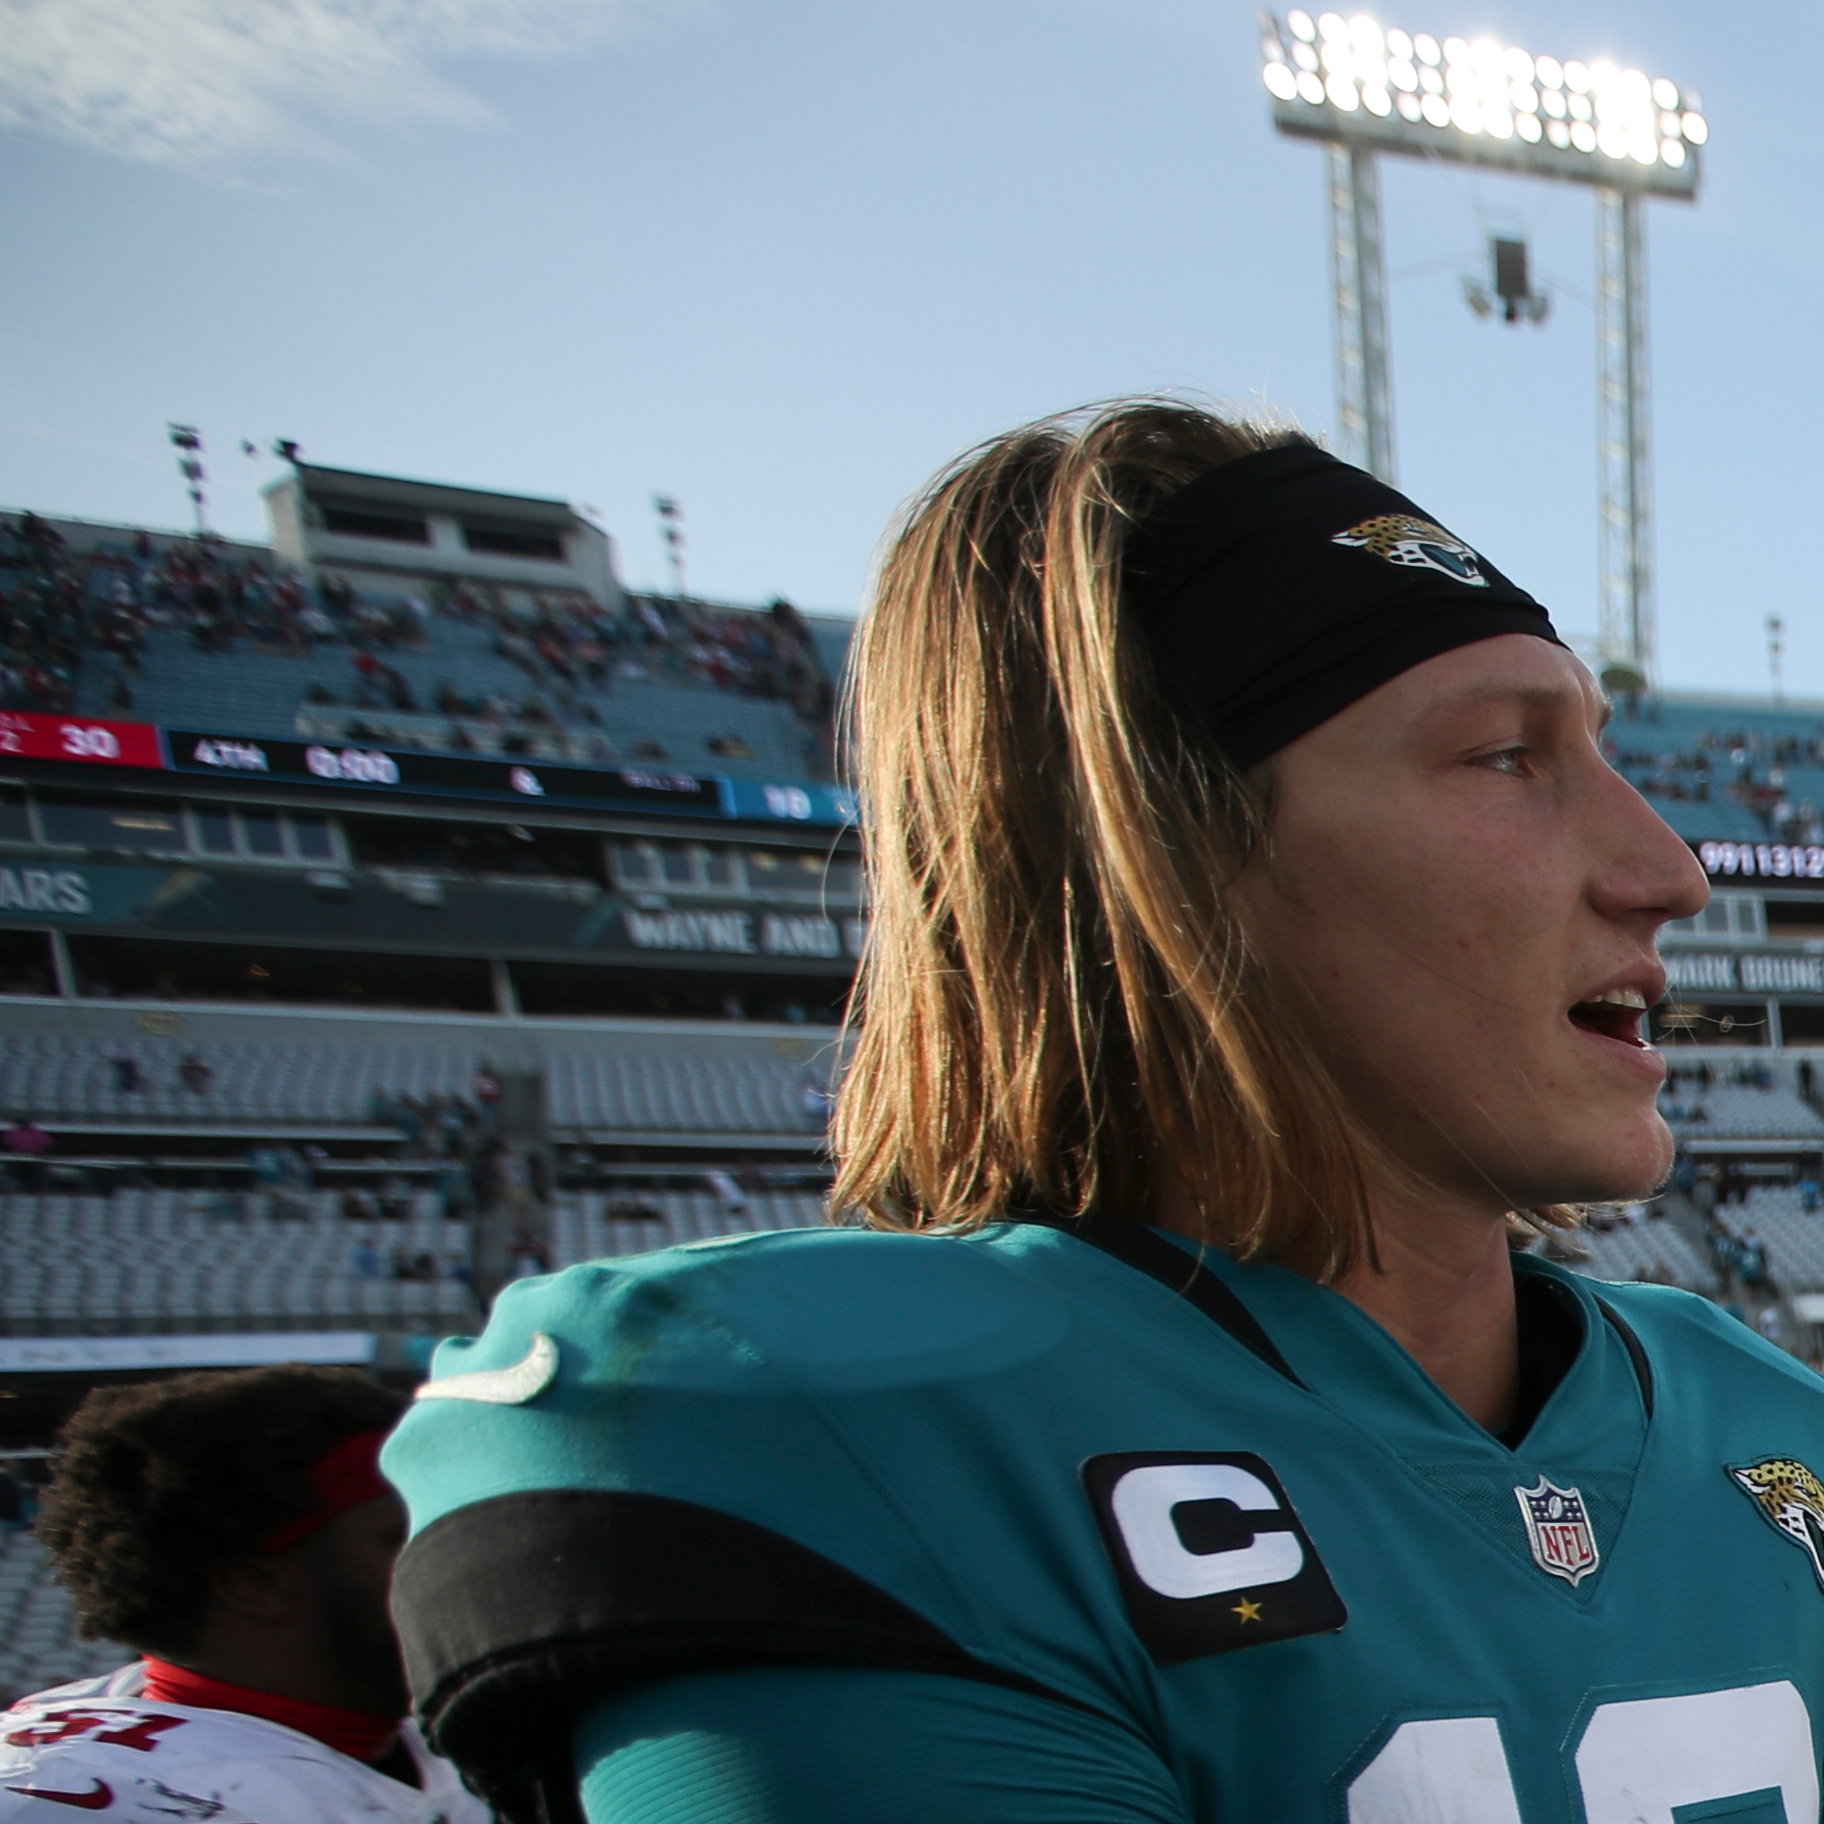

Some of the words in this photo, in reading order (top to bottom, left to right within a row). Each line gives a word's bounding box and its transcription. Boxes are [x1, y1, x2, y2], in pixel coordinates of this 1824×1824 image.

[59, 722, 121, 759] 30
[623, 907, 758, 955] WAYNE
[759, 912, 842, 958] AND
[1111, 1463, 1305, 1599] C
[1541, 1525, 1591, 1566] NFL
